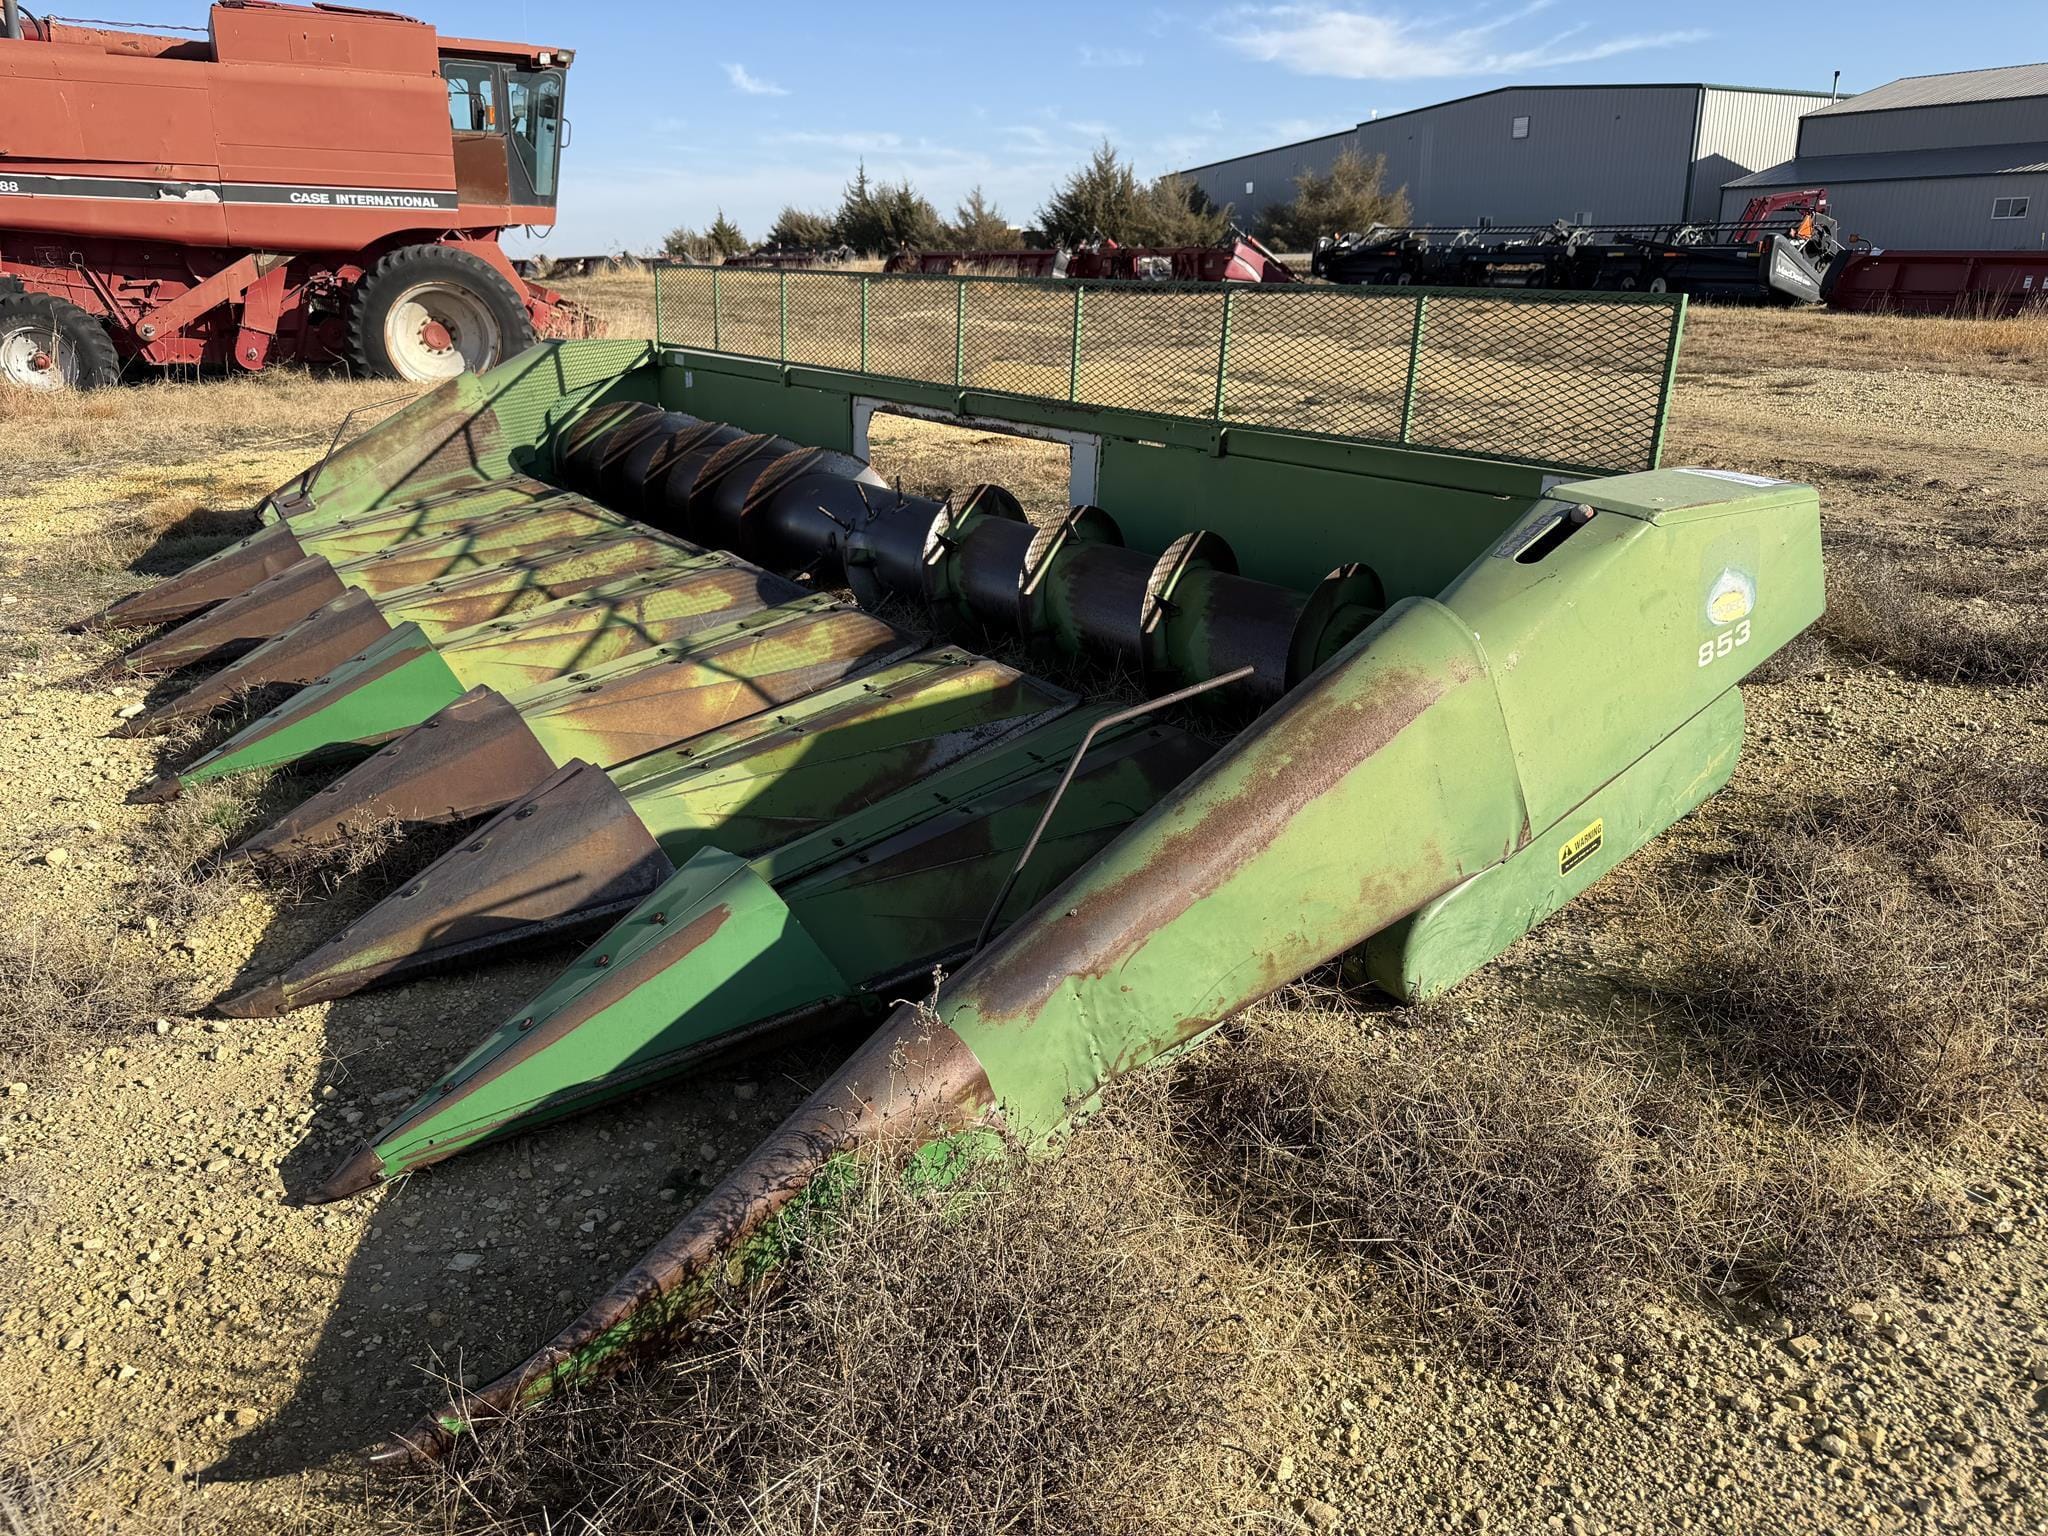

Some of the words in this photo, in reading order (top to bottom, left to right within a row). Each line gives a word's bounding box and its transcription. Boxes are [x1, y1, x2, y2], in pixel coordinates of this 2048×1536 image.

[0, 181, 19, 192] 88
[290, 192, 330, 204] CASE
[335, 194, 439, 208] INTERNATIONAL
[1698, 619, 1751, 668] 853
[1574, 823, 1602, 851] WARNING
